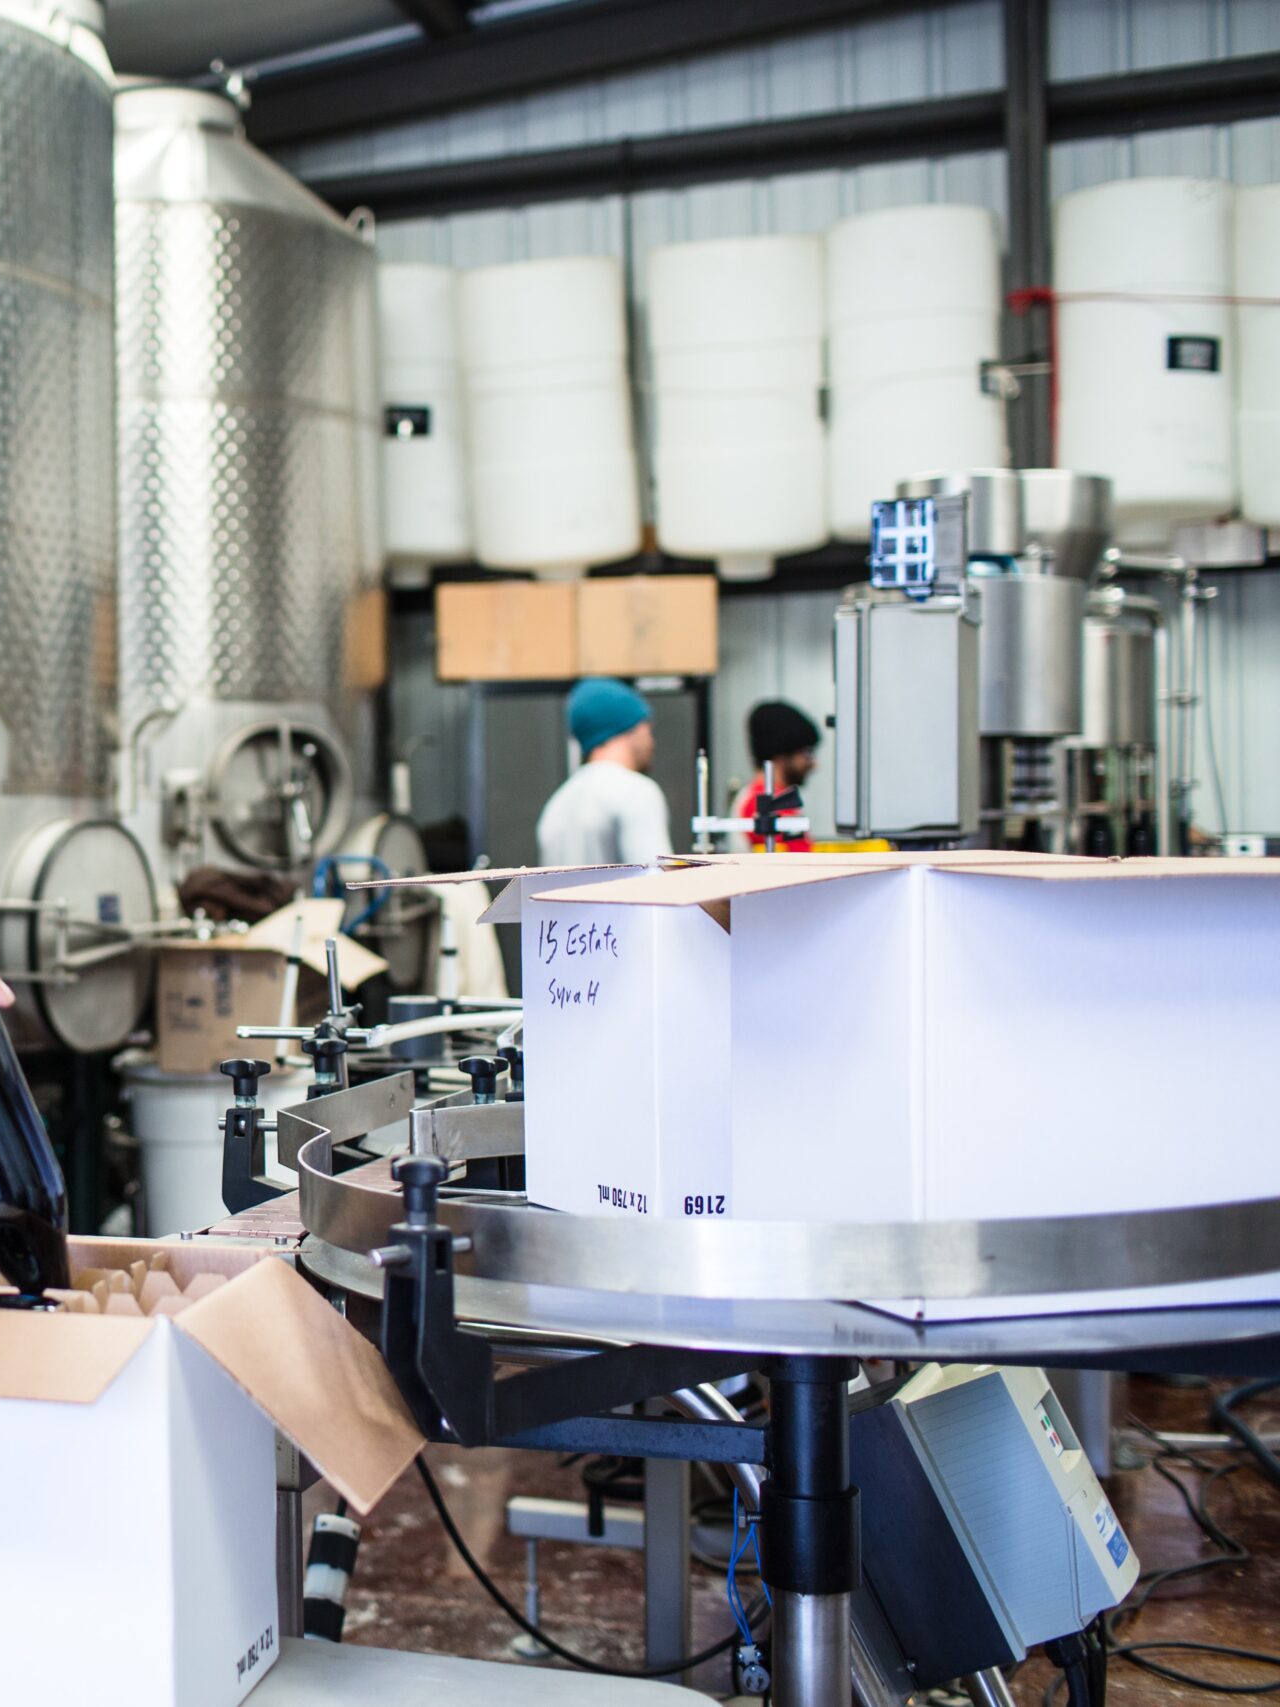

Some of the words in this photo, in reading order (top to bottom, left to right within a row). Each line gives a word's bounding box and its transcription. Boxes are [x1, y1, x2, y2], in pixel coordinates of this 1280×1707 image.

[539, 920, 558, 964] 15
[566, 922, 618, 958] Estate
[597, 1184, 610, 1204] mL
[612, 1187, 628, 1209] 750
[637, 1193, 648, 1214] 12
[684, 1195, 725, 1215] 2169
